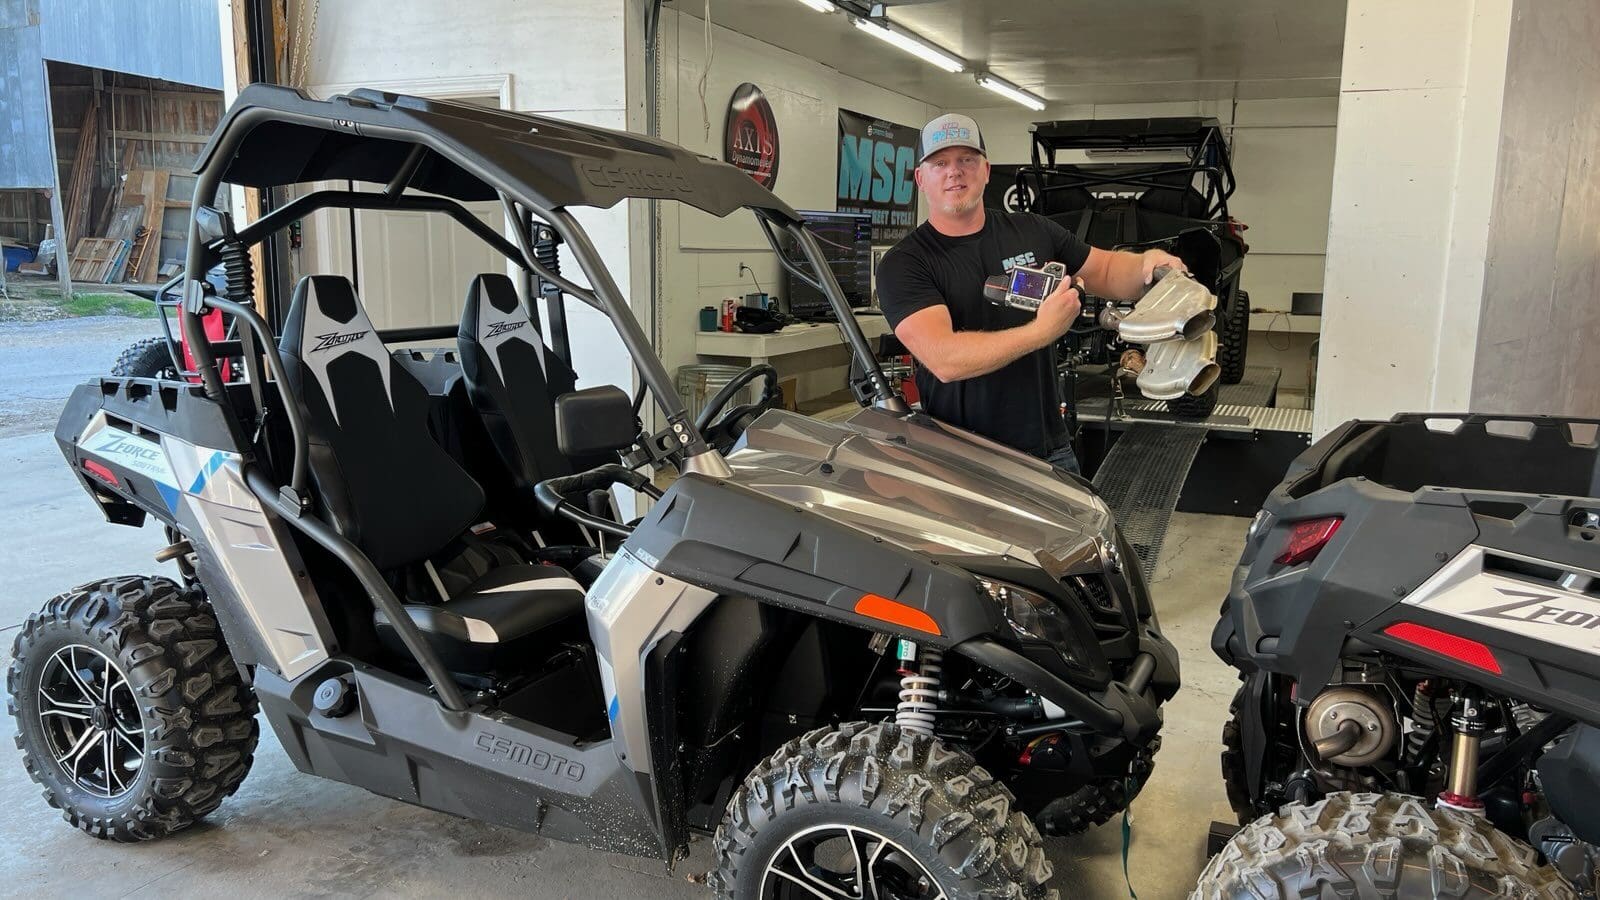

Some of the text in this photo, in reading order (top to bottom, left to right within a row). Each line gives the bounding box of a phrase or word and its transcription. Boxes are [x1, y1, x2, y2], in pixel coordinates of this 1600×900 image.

[733, 126, 773, 156] AXIS
[581, 163, 695, 194] CFMOTO
[839, 134, 914, 205] MSC
[1002, 251, 1036, 271] MSC
[474, 730, 586, 782] CFMOTO
